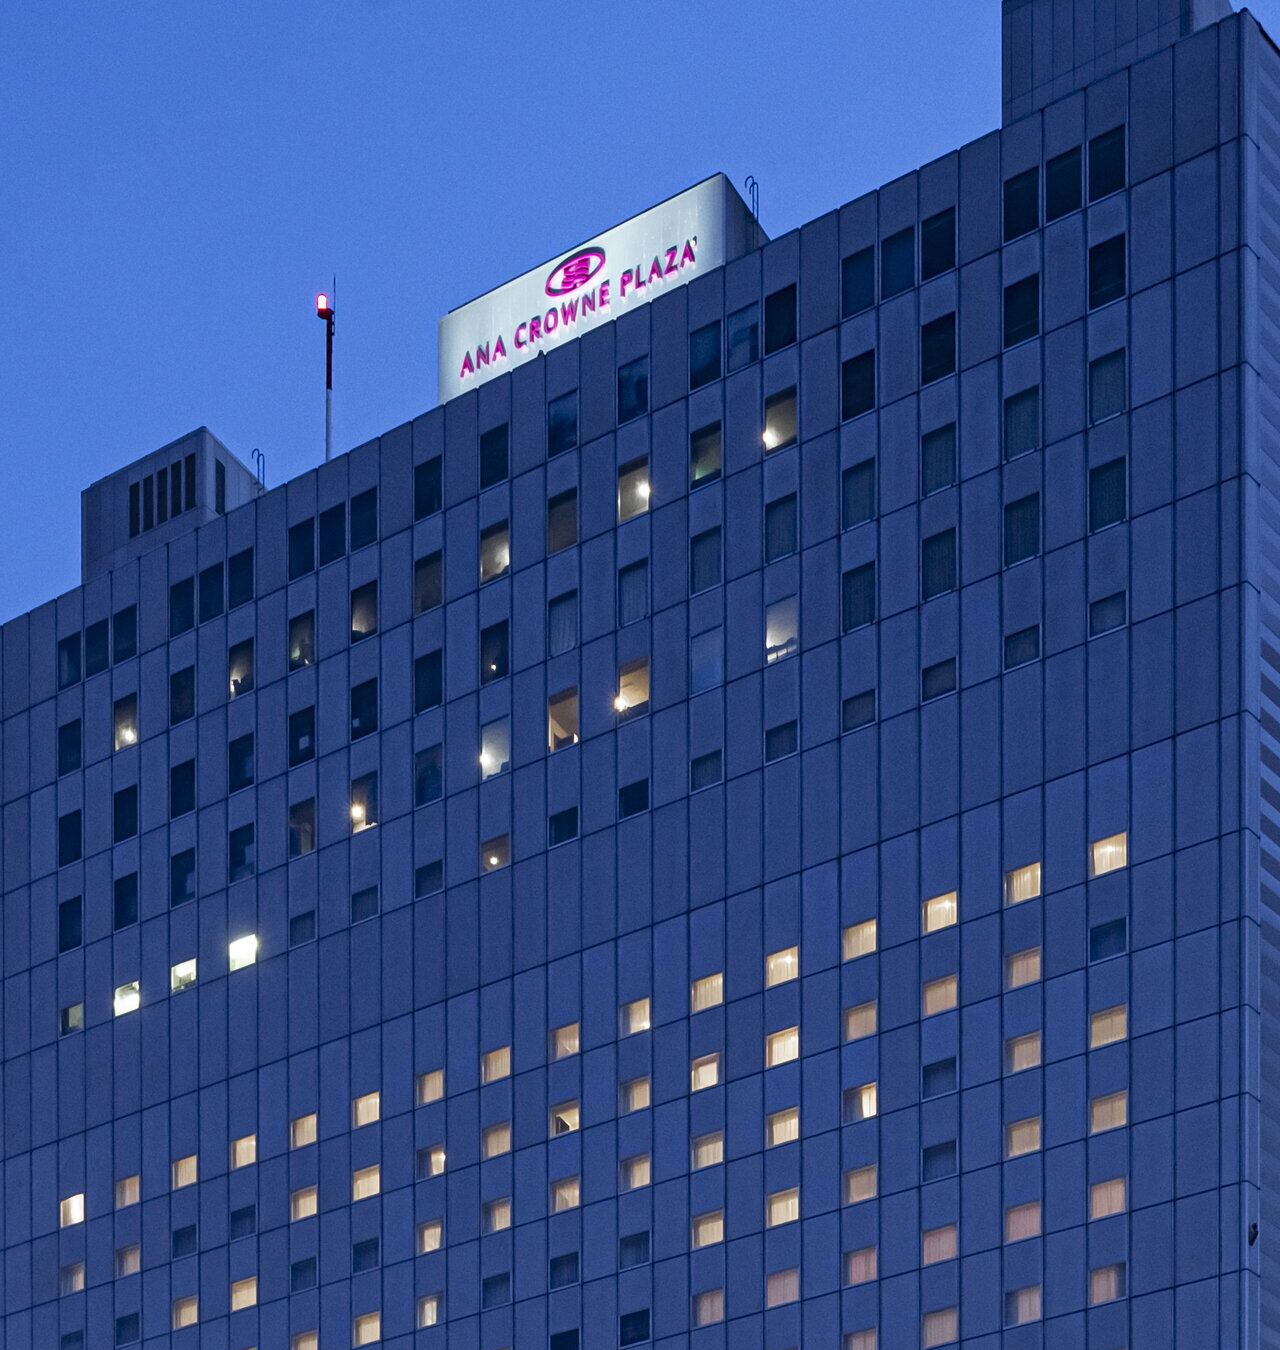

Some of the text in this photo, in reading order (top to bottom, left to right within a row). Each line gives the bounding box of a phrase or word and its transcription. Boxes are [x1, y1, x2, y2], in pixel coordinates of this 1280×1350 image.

[460, 238, 697, 378] ANA CROWNE PLAZA
